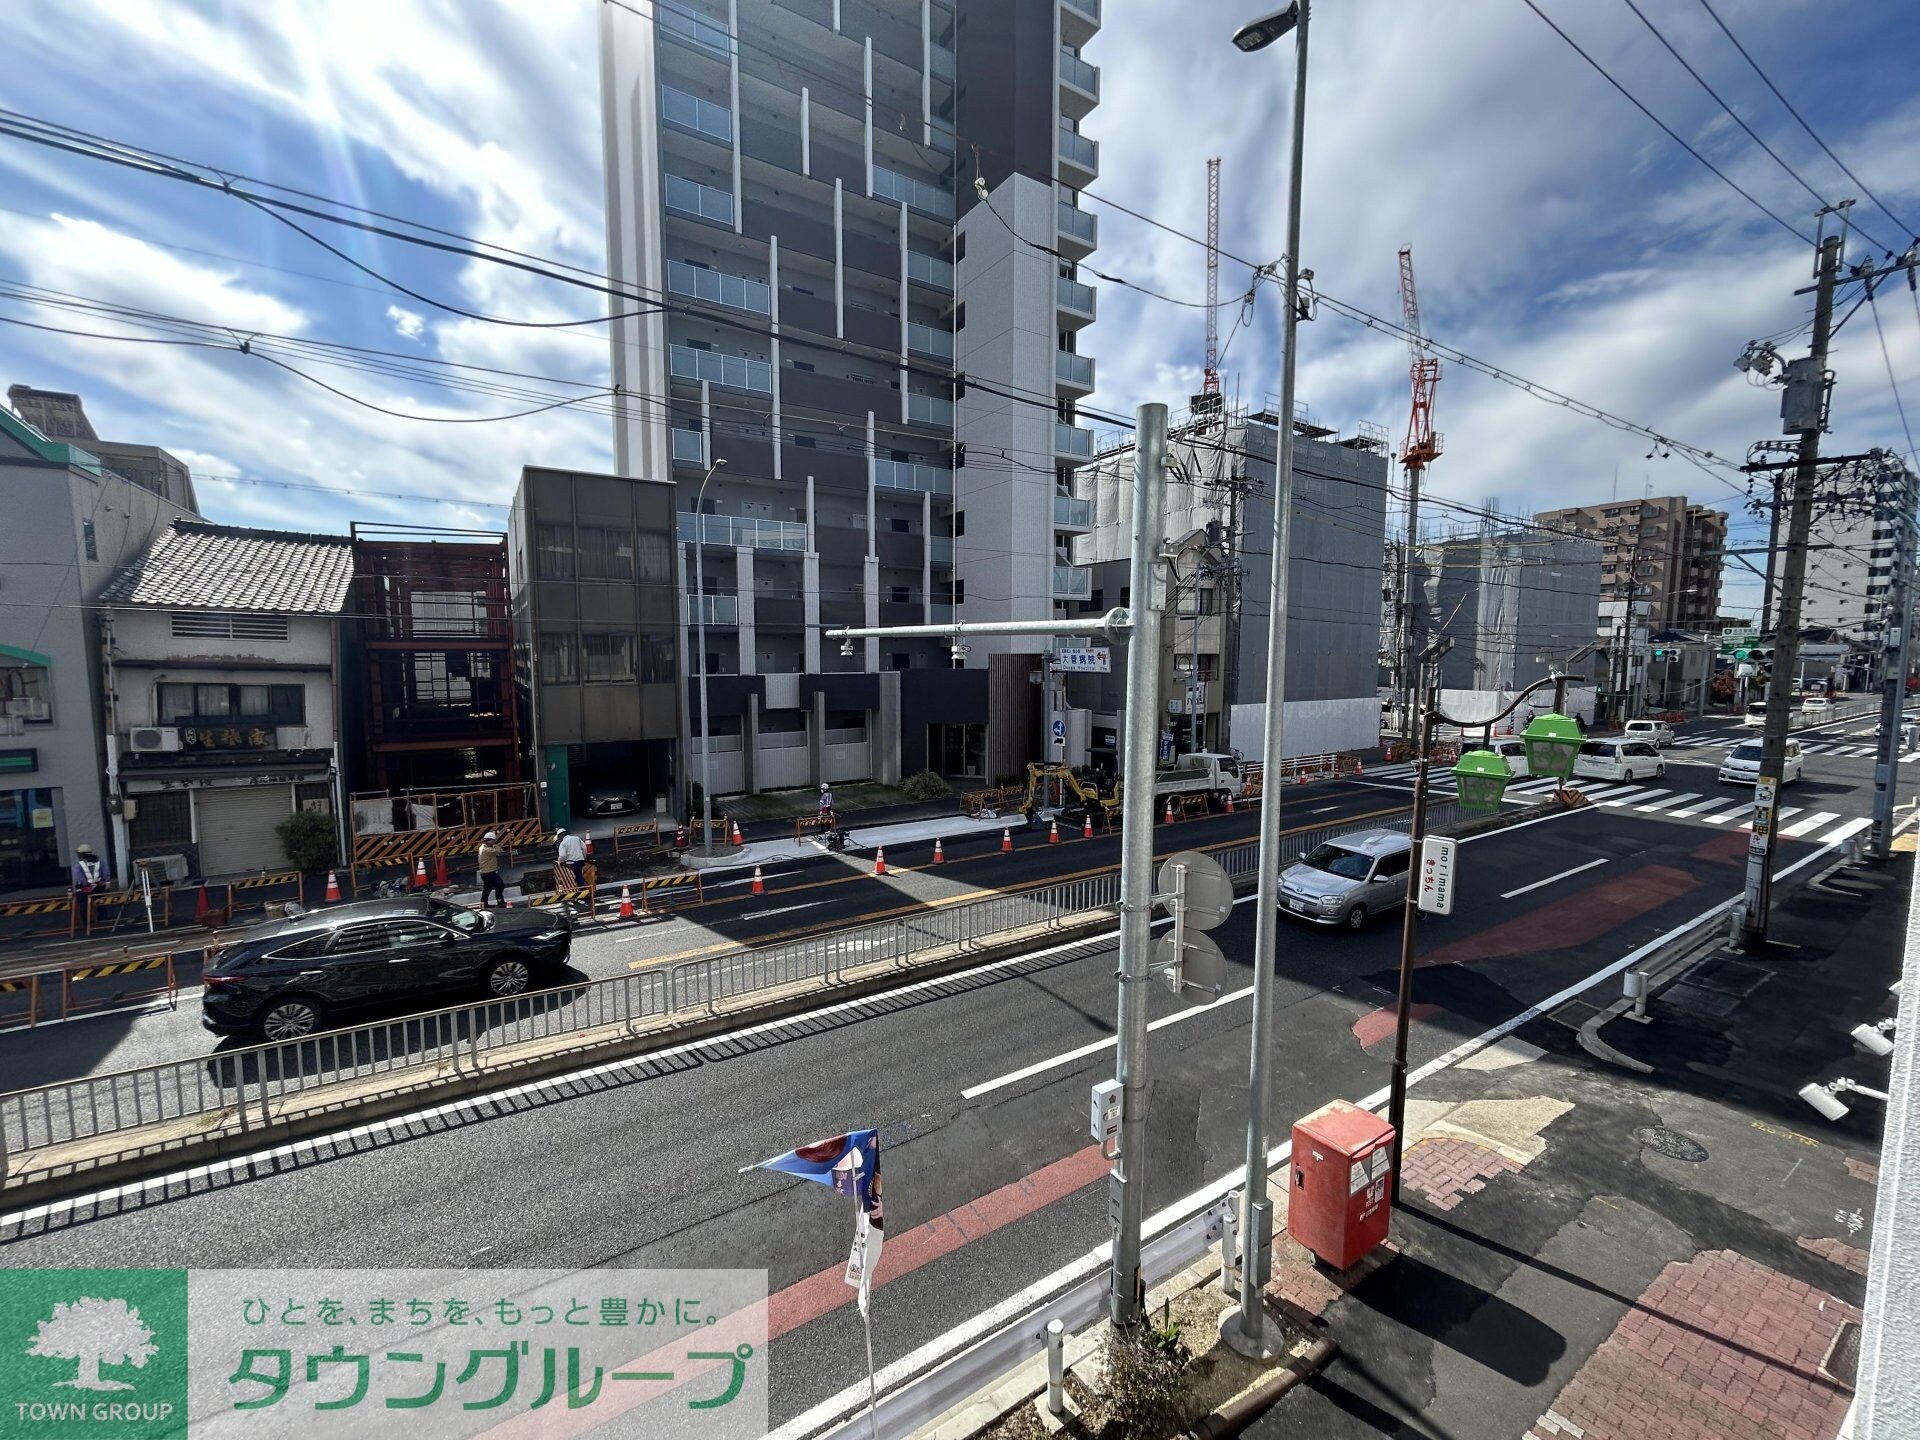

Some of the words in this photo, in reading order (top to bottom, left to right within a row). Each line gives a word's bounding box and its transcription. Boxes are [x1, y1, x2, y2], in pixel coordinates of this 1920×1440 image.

[1424, 859, 1436, 893] きっちん
[1436, 846, 1449, 909] morimama
